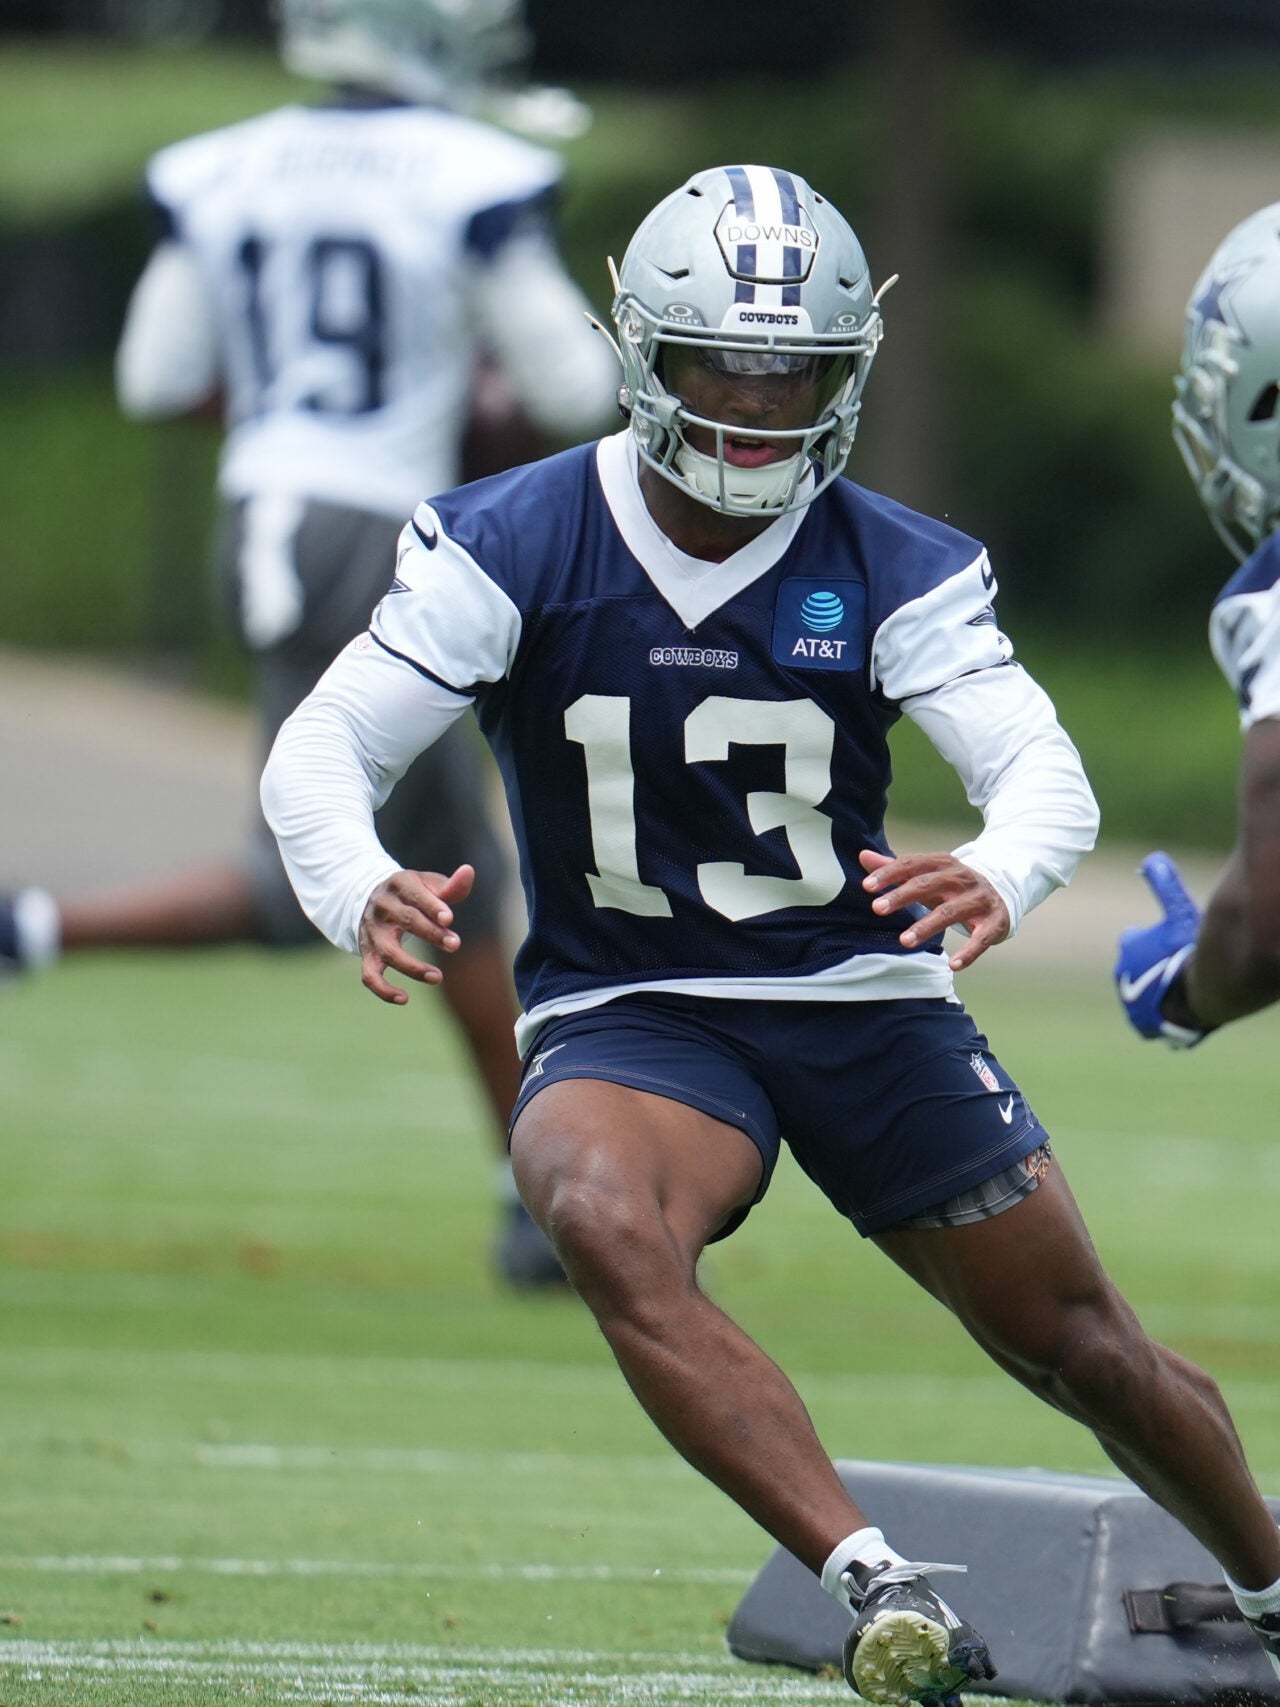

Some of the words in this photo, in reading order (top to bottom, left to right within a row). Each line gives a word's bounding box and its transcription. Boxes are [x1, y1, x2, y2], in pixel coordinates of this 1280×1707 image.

[727, 225, 812, 247] DOWNS
[235, 233, 388, 418] 19
[739, 311, 798, 325] COWBOYS
[649, 647, 738, 669] COWBOYS
[792, 637, 847, 659] AT&T
[563, 693, 847, 923] 13
